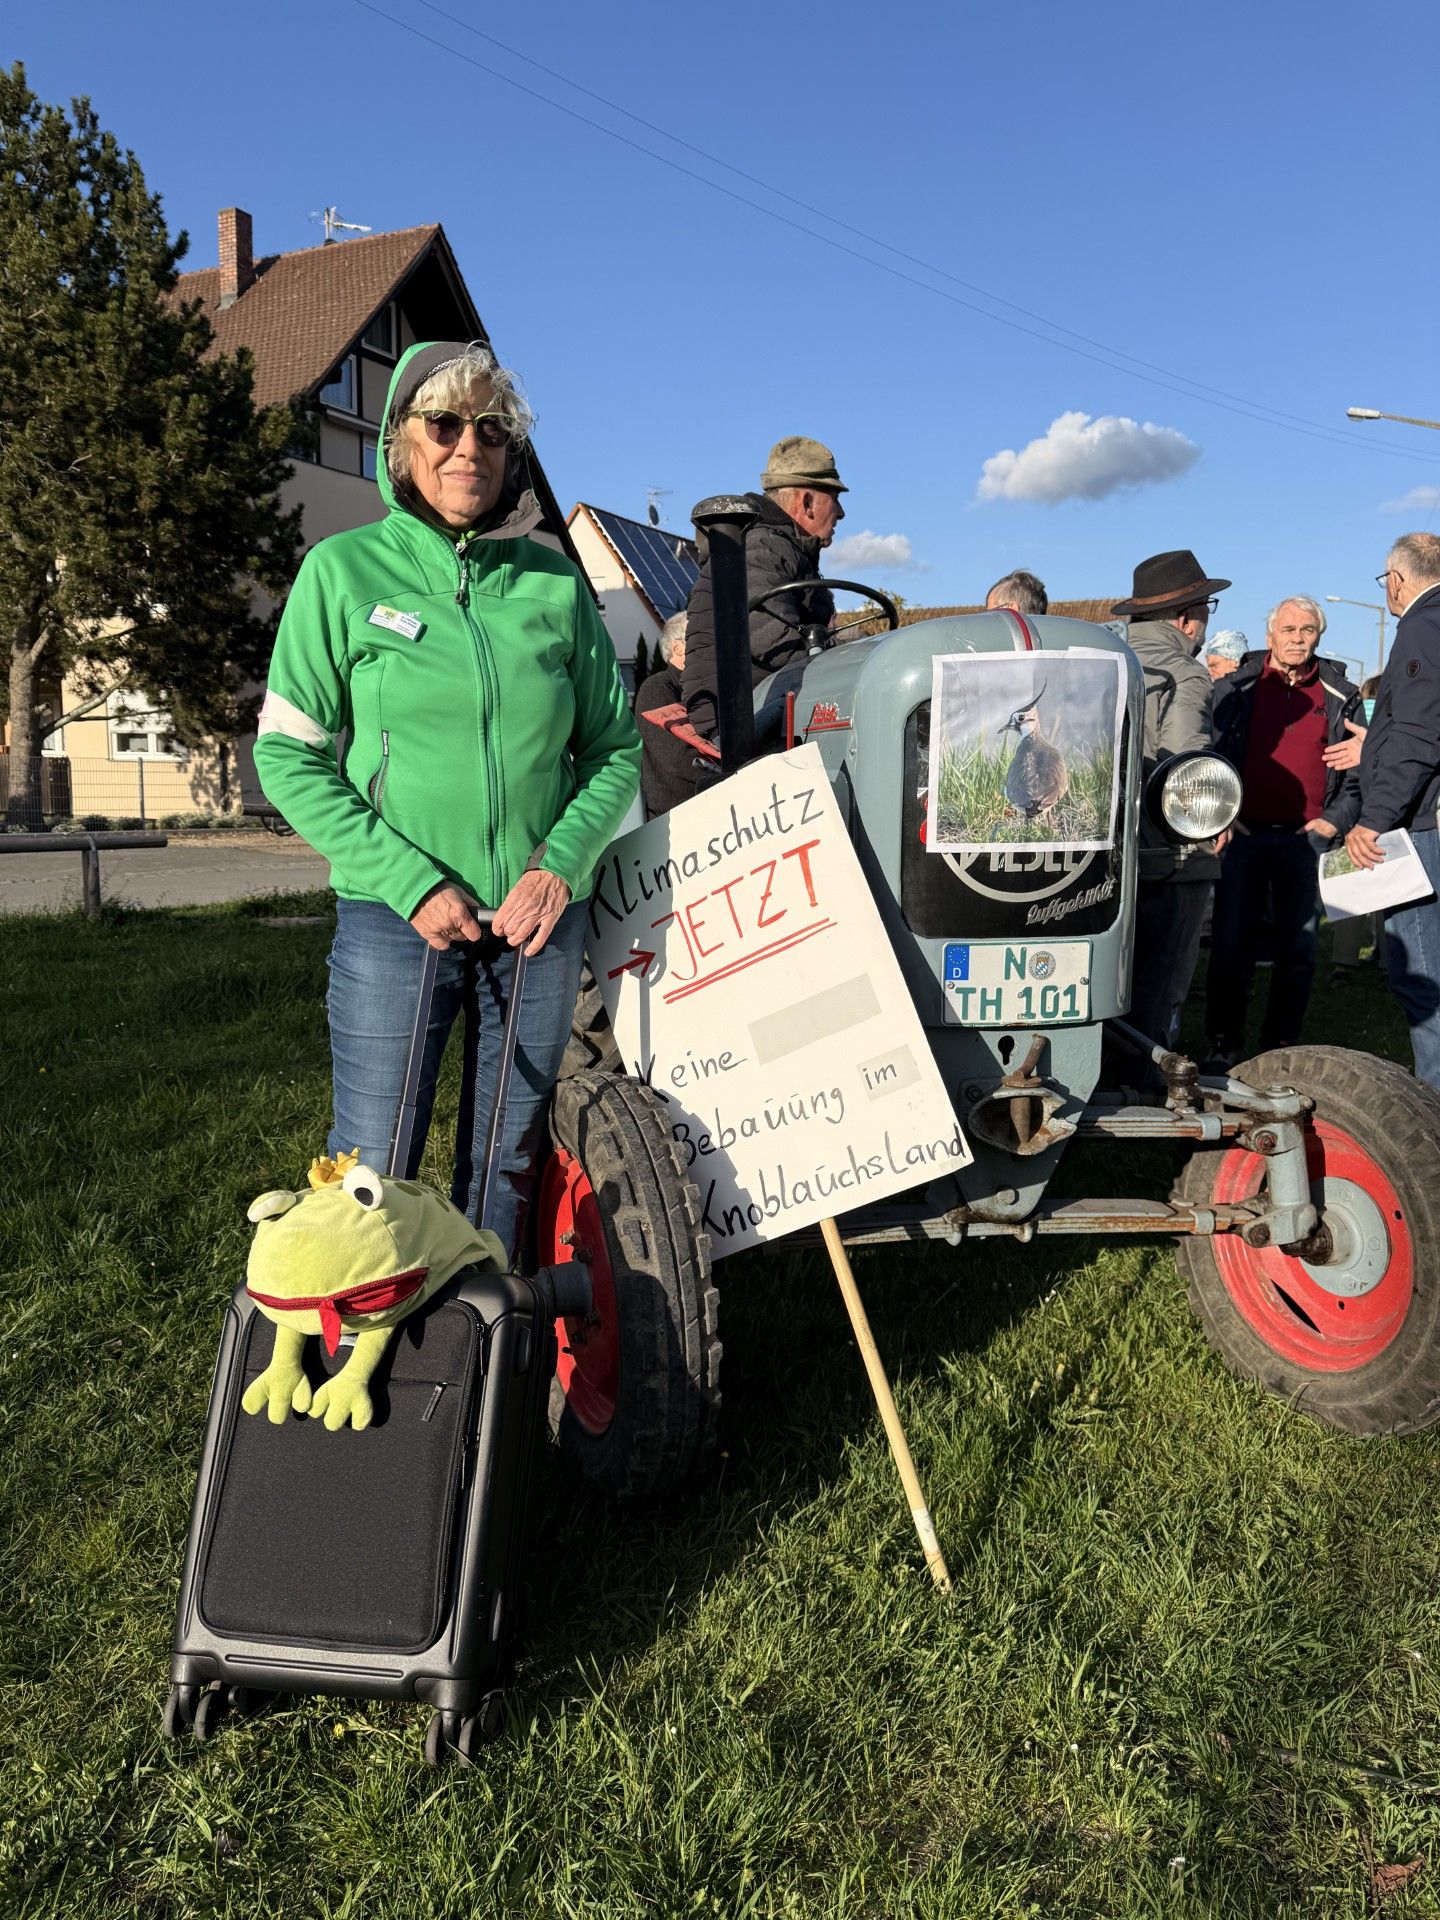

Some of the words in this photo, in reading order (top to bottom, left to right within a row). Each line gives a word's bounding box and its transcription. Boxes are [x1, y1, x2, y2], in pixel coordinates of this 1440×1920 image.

[588, 783, 824, 940] Klimaschutz
[651, 839, 821, 981] JETZT
[952, 967, 962, 979] D
[1004, 946, 1027, 980] N
[955, 987, 1003, 1021] TH
[1017, 984, 1080, 1020] 101
[634, 1052, 748, 1103] Keine
[672, 1087, 845, 1167] Bebauung
[862, 1063, 899, 1090] im
